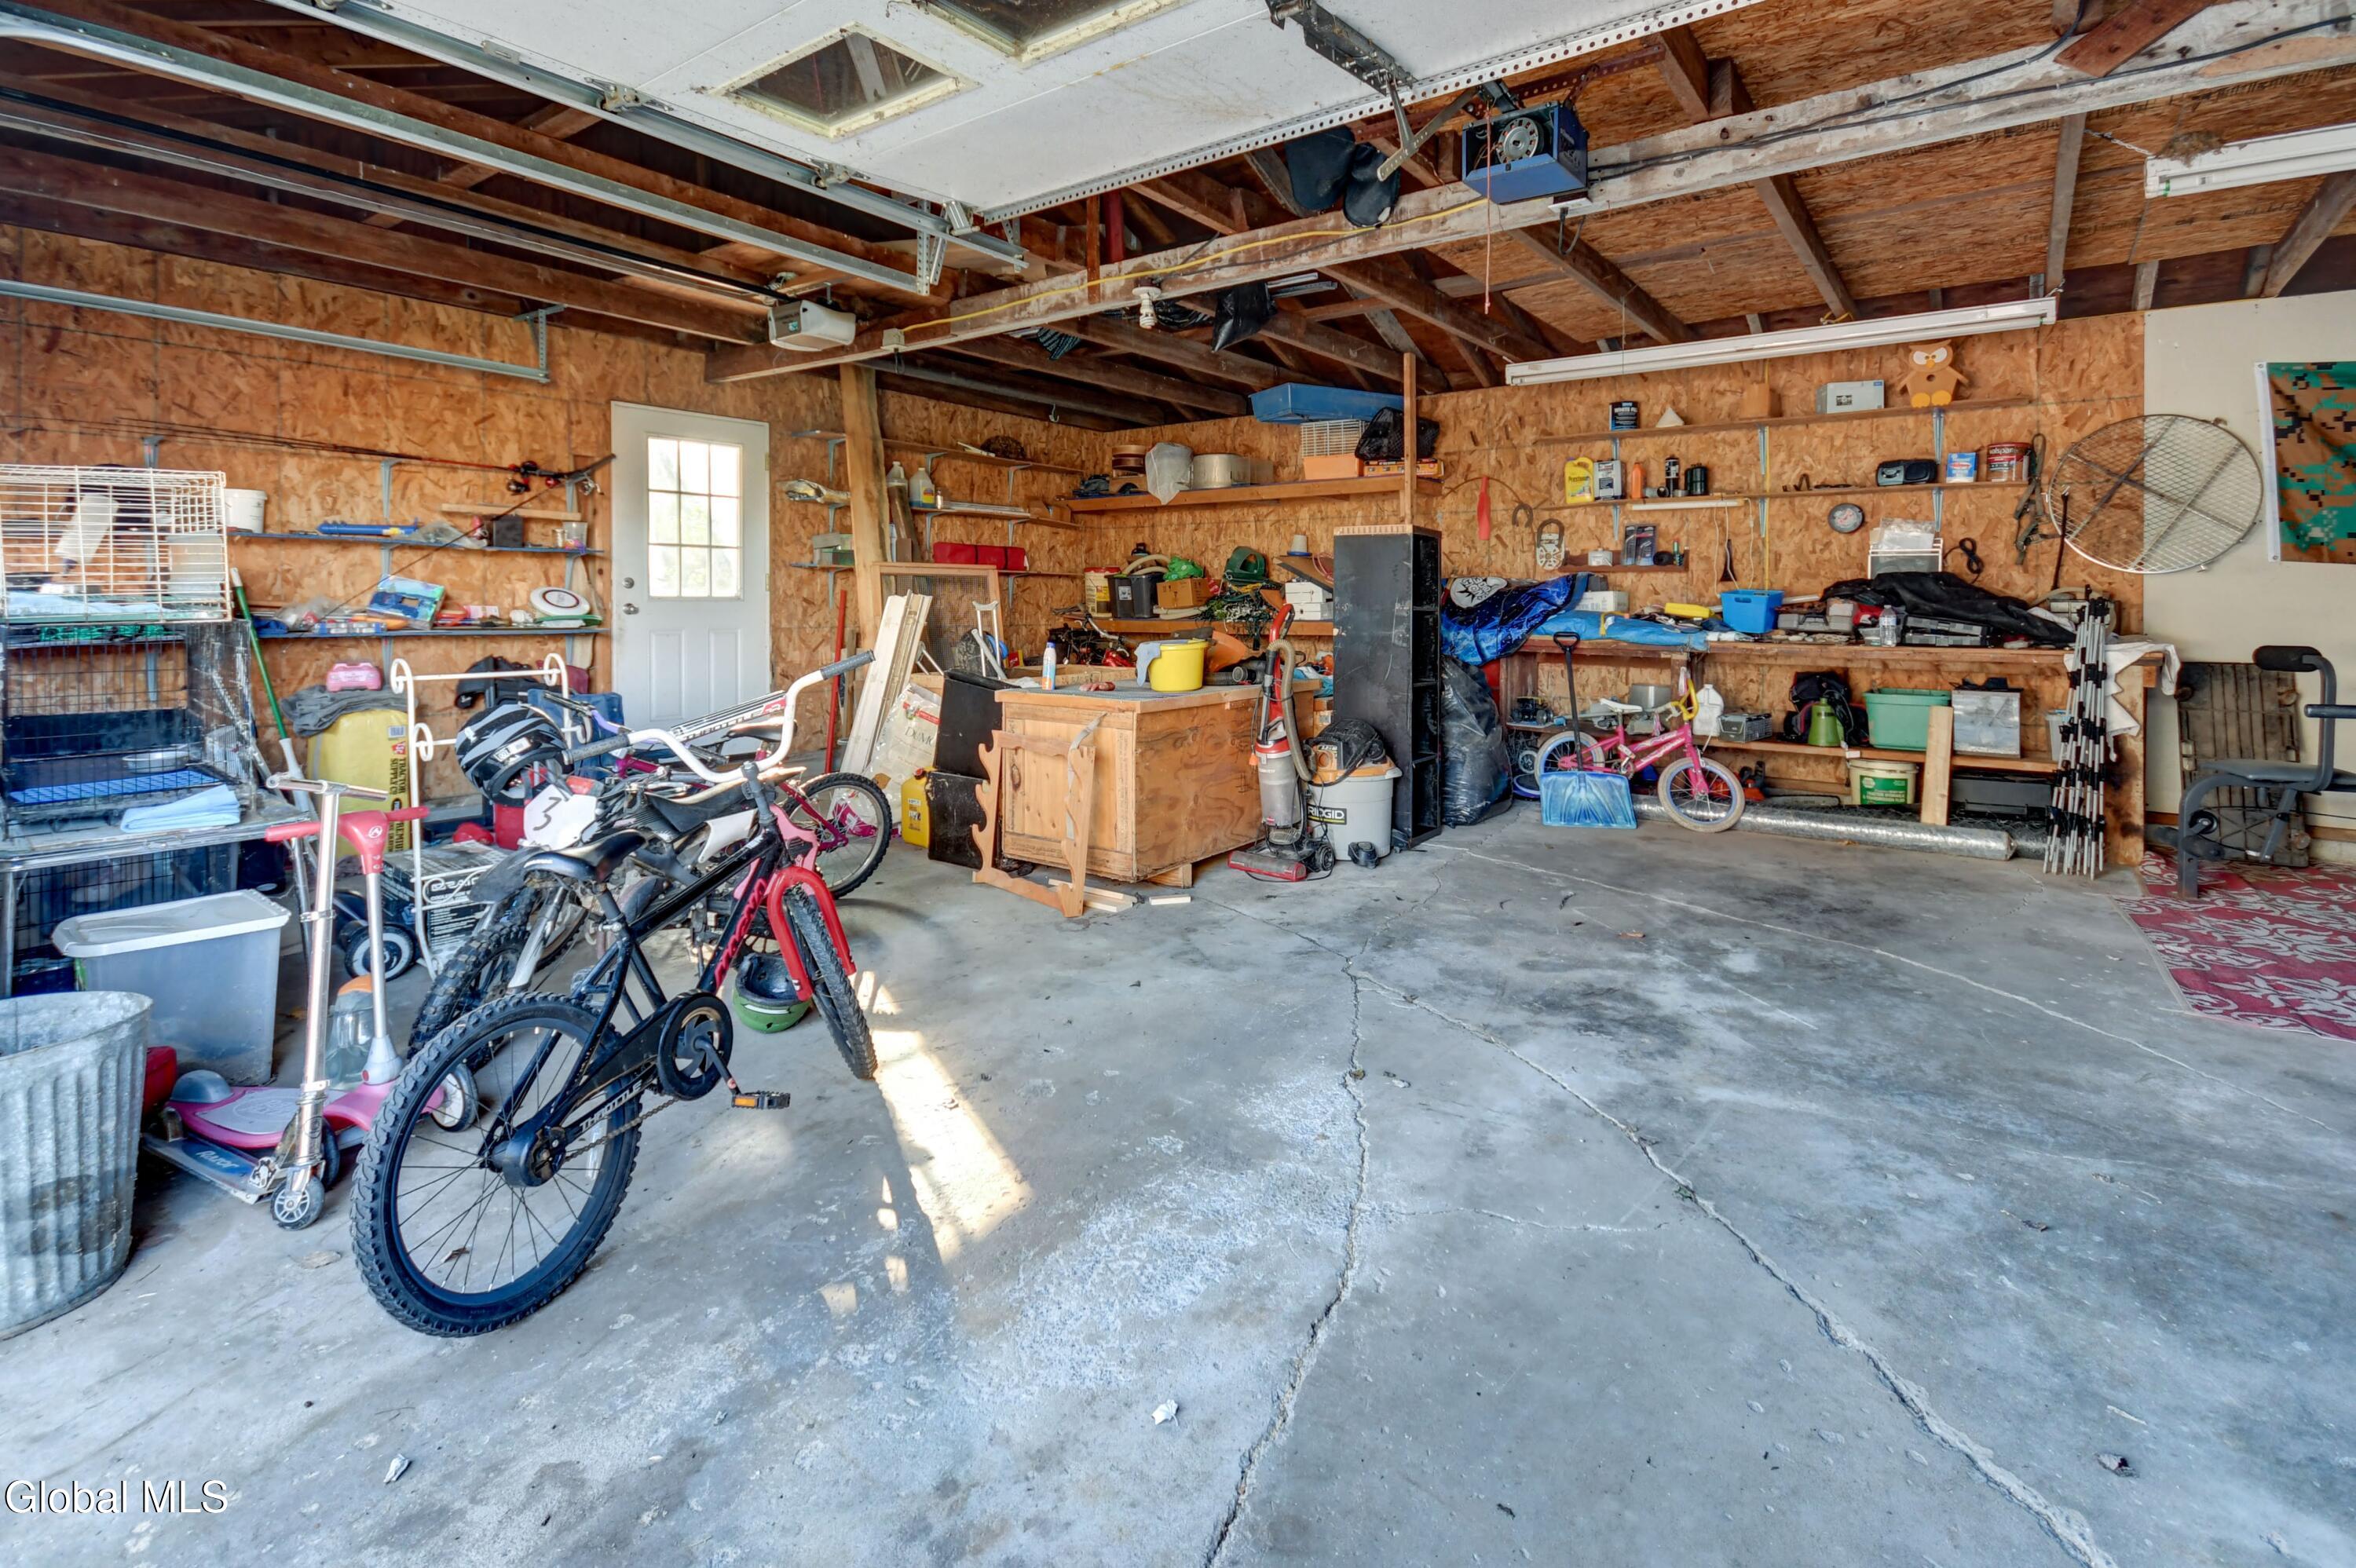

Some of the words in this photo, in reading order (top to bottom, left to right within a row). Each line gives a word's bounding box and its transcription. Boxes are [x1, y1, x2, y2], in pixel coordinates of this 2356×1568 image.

[390, 758, 398, 785] SUPPLY
[579, 1079, 642, 1133] THROTTLE
[196, 1150, 240, 1168] Razor
